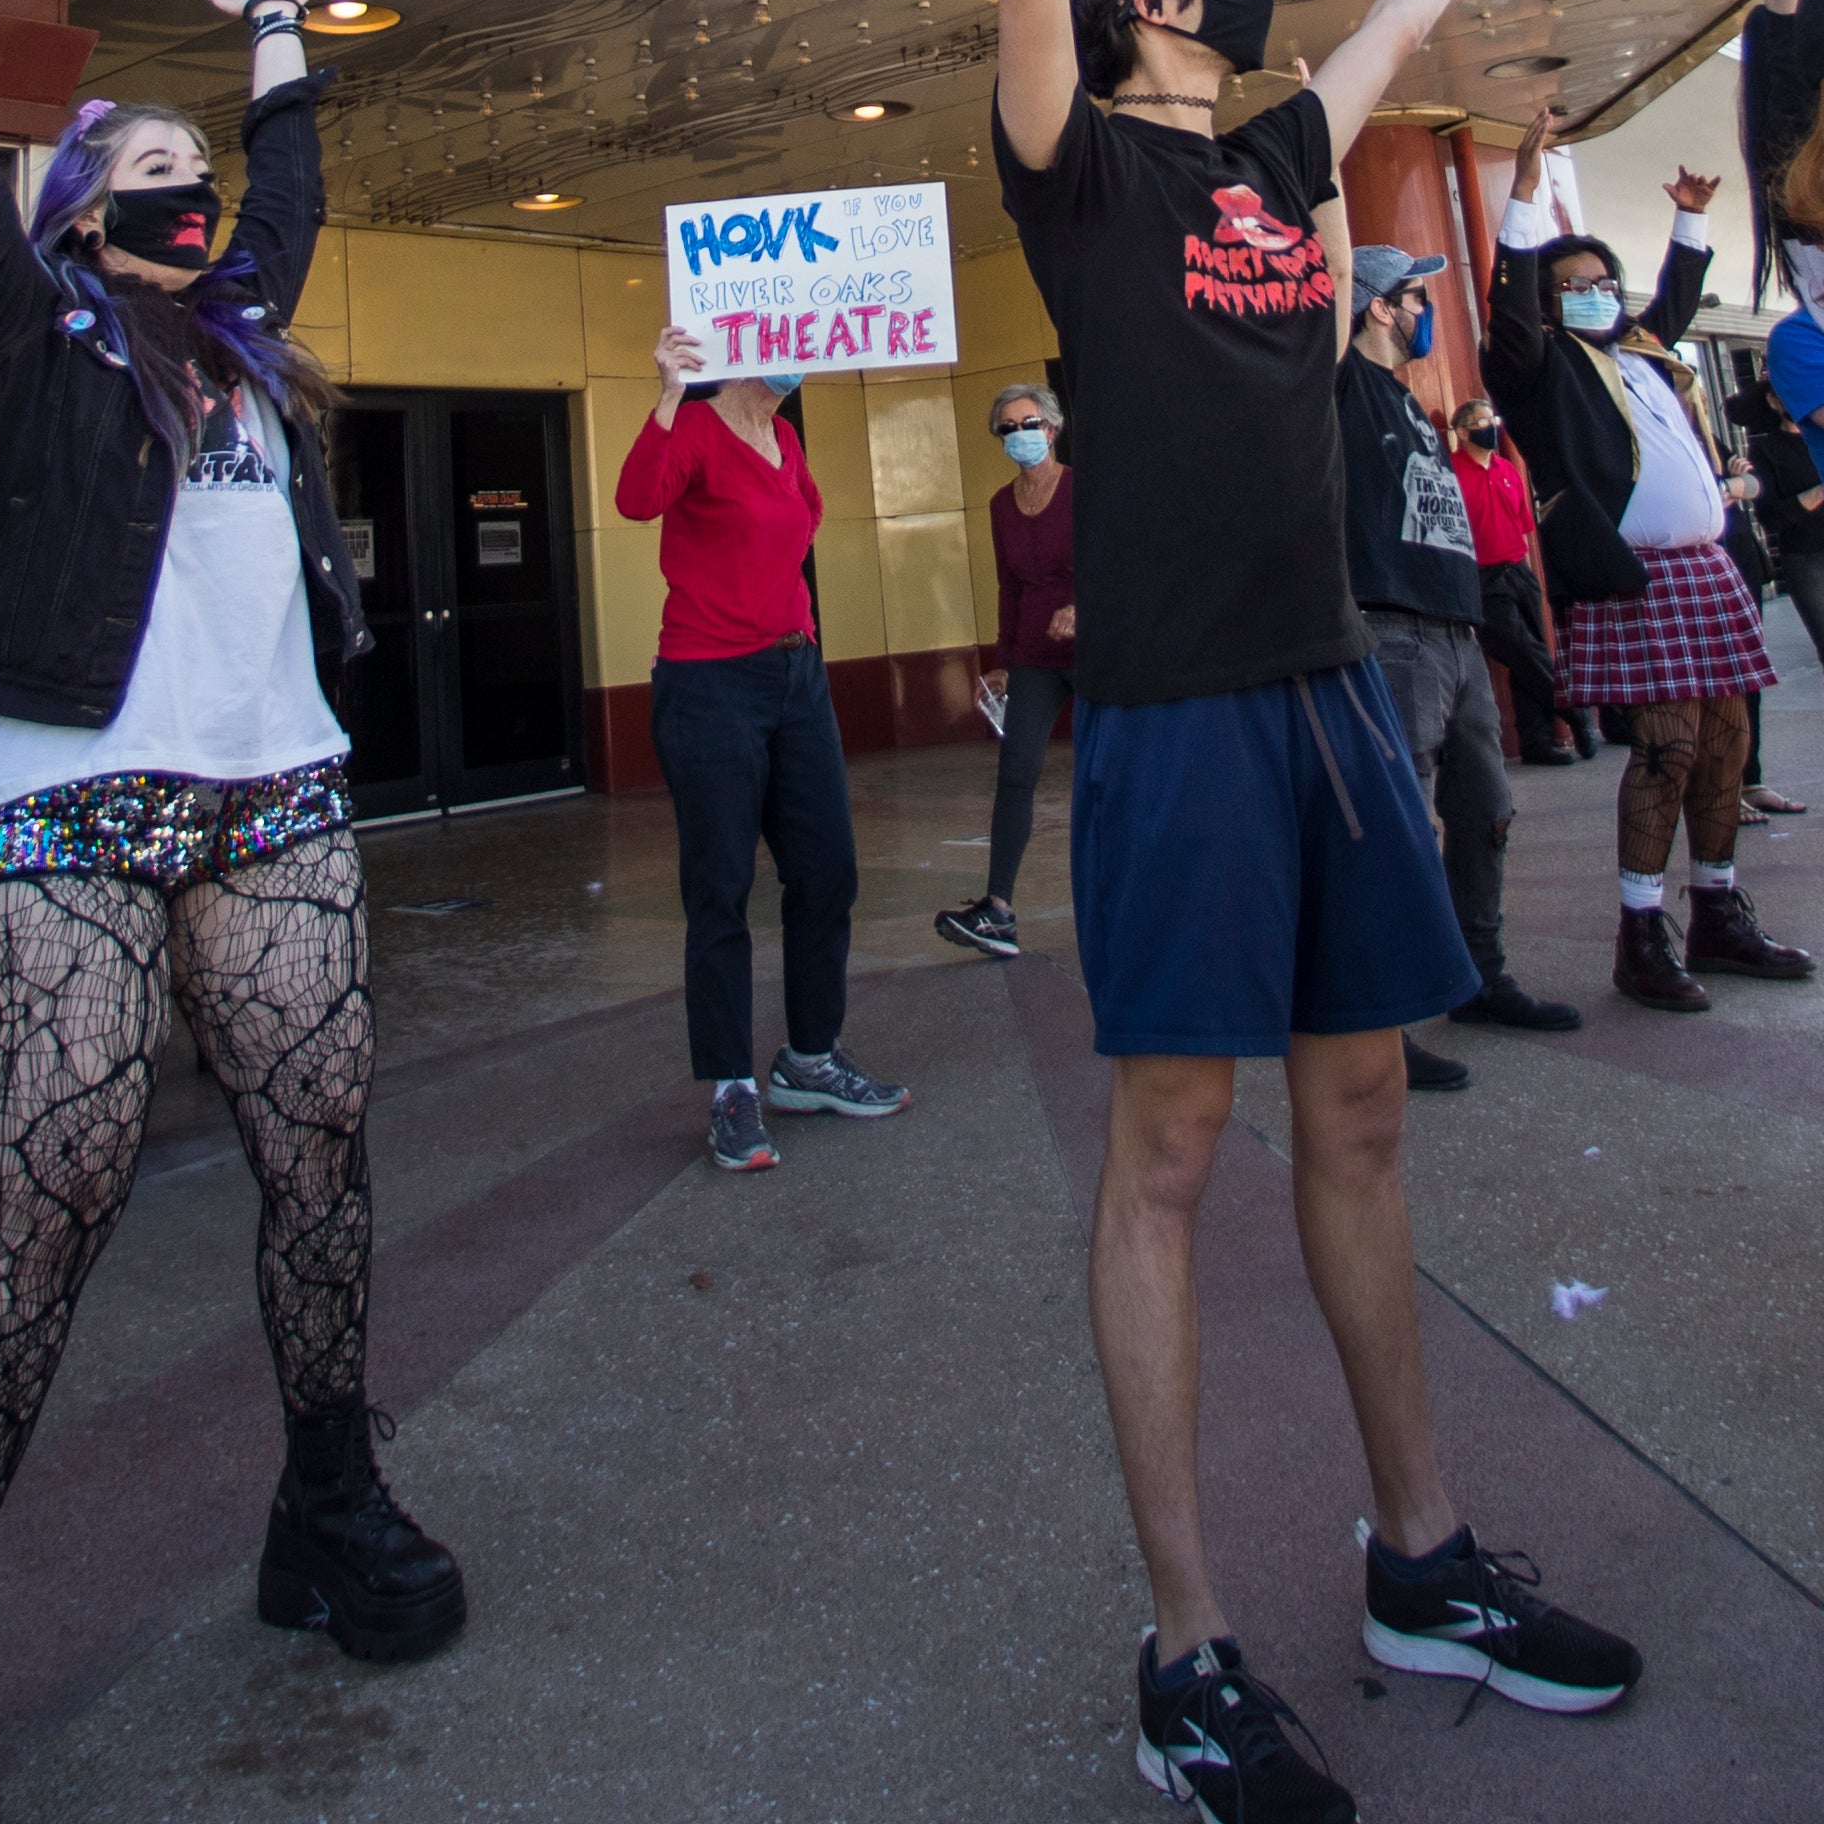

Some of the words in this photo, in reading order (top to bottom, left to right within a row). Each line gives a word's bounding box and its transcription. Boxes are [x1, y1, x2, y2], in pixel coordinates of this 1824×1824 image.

[843, 197, 862, 216] IF
[874, 193, 922, 216] YOU
[851, 216, 934, 261] LOVE
[690, 275, 795, 314] RIVER
[810, 270, 913, 305] OAKS
[1184, 271, 1298, 318] PICTURE
[712, 304, 936, 366] THEATRE
[179, 481, 206, 492] ROYAL
[208, 482, 236, 492] MYSTIC
[238, 483, 264, 492] ORDER
